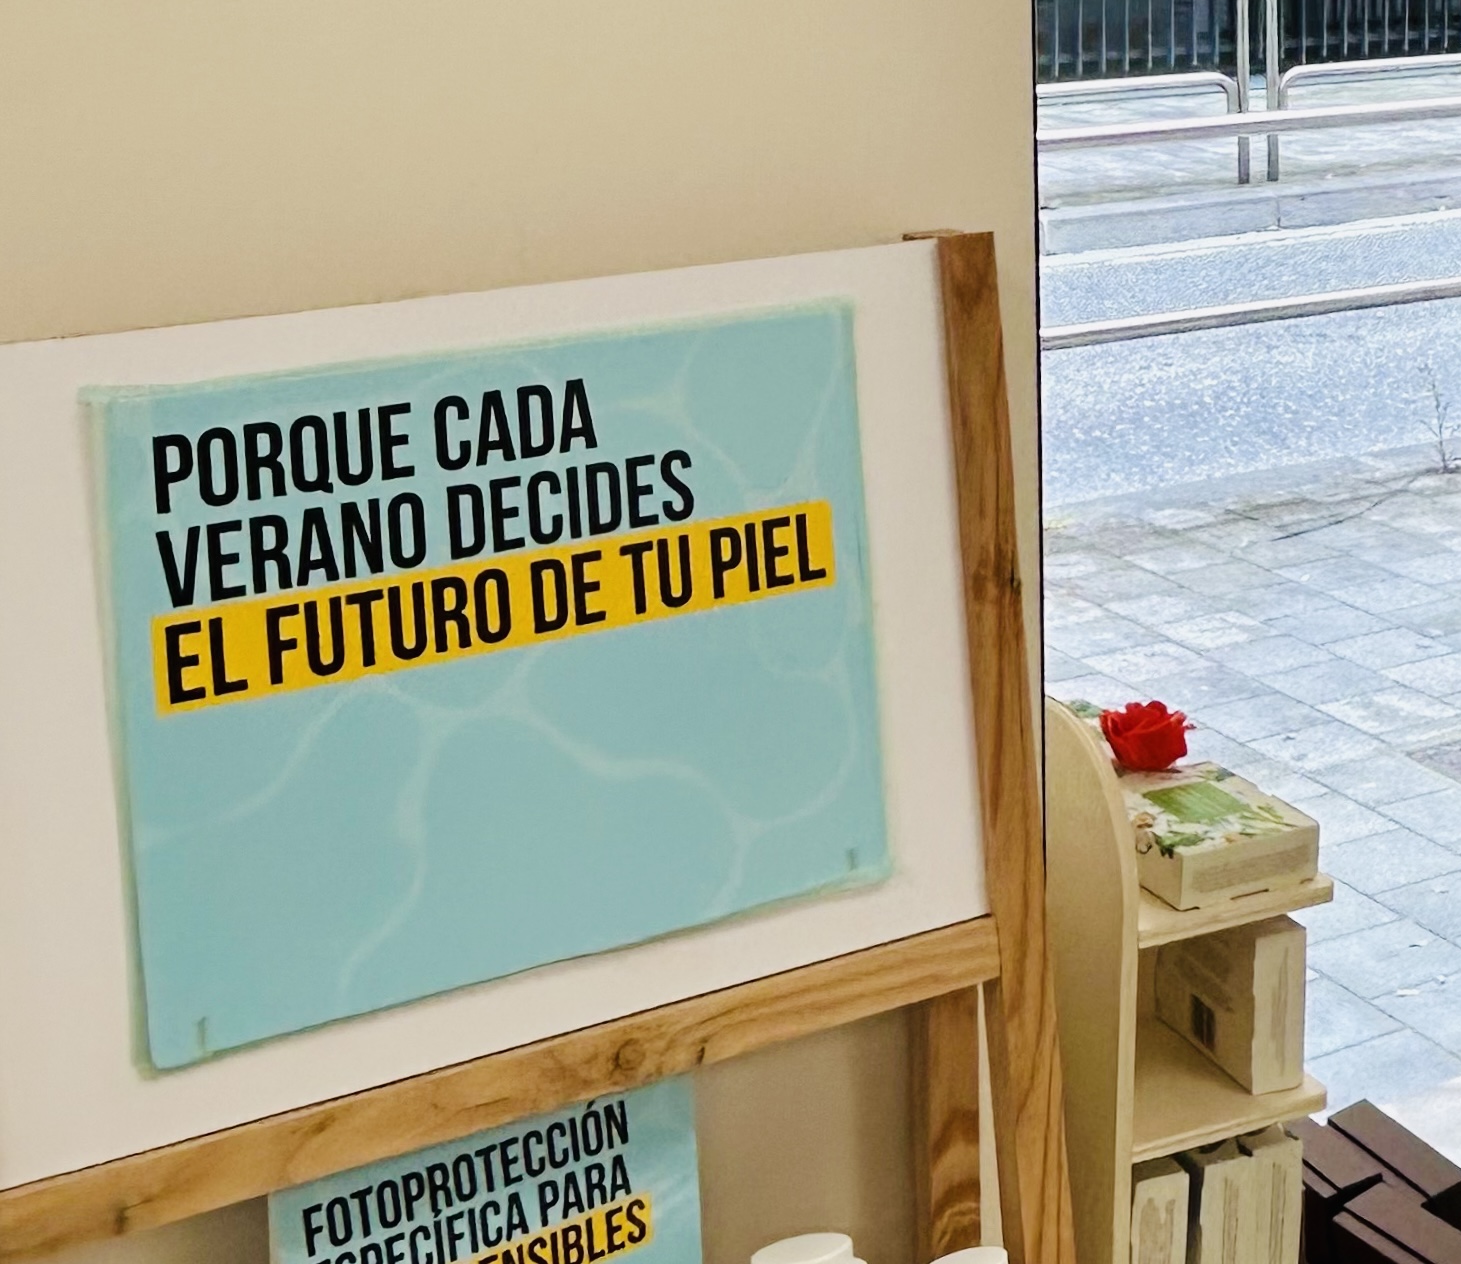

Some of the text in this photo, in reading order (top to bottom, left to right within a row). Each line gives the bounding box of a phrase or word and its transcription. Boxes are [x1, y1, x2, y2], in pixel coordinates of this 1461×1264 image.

[152, 378, 598, 514] PORQUE CADA
[155, 449, 695, 608] VERANO DECIDES
[165, 513, 828, 706] EL FUTURO DE TU PIEL
[302, 1099, 630, 1257] FOTOPROTECCIÓN
[317, 1154, 632, 1264] ECÍFICA PARA
